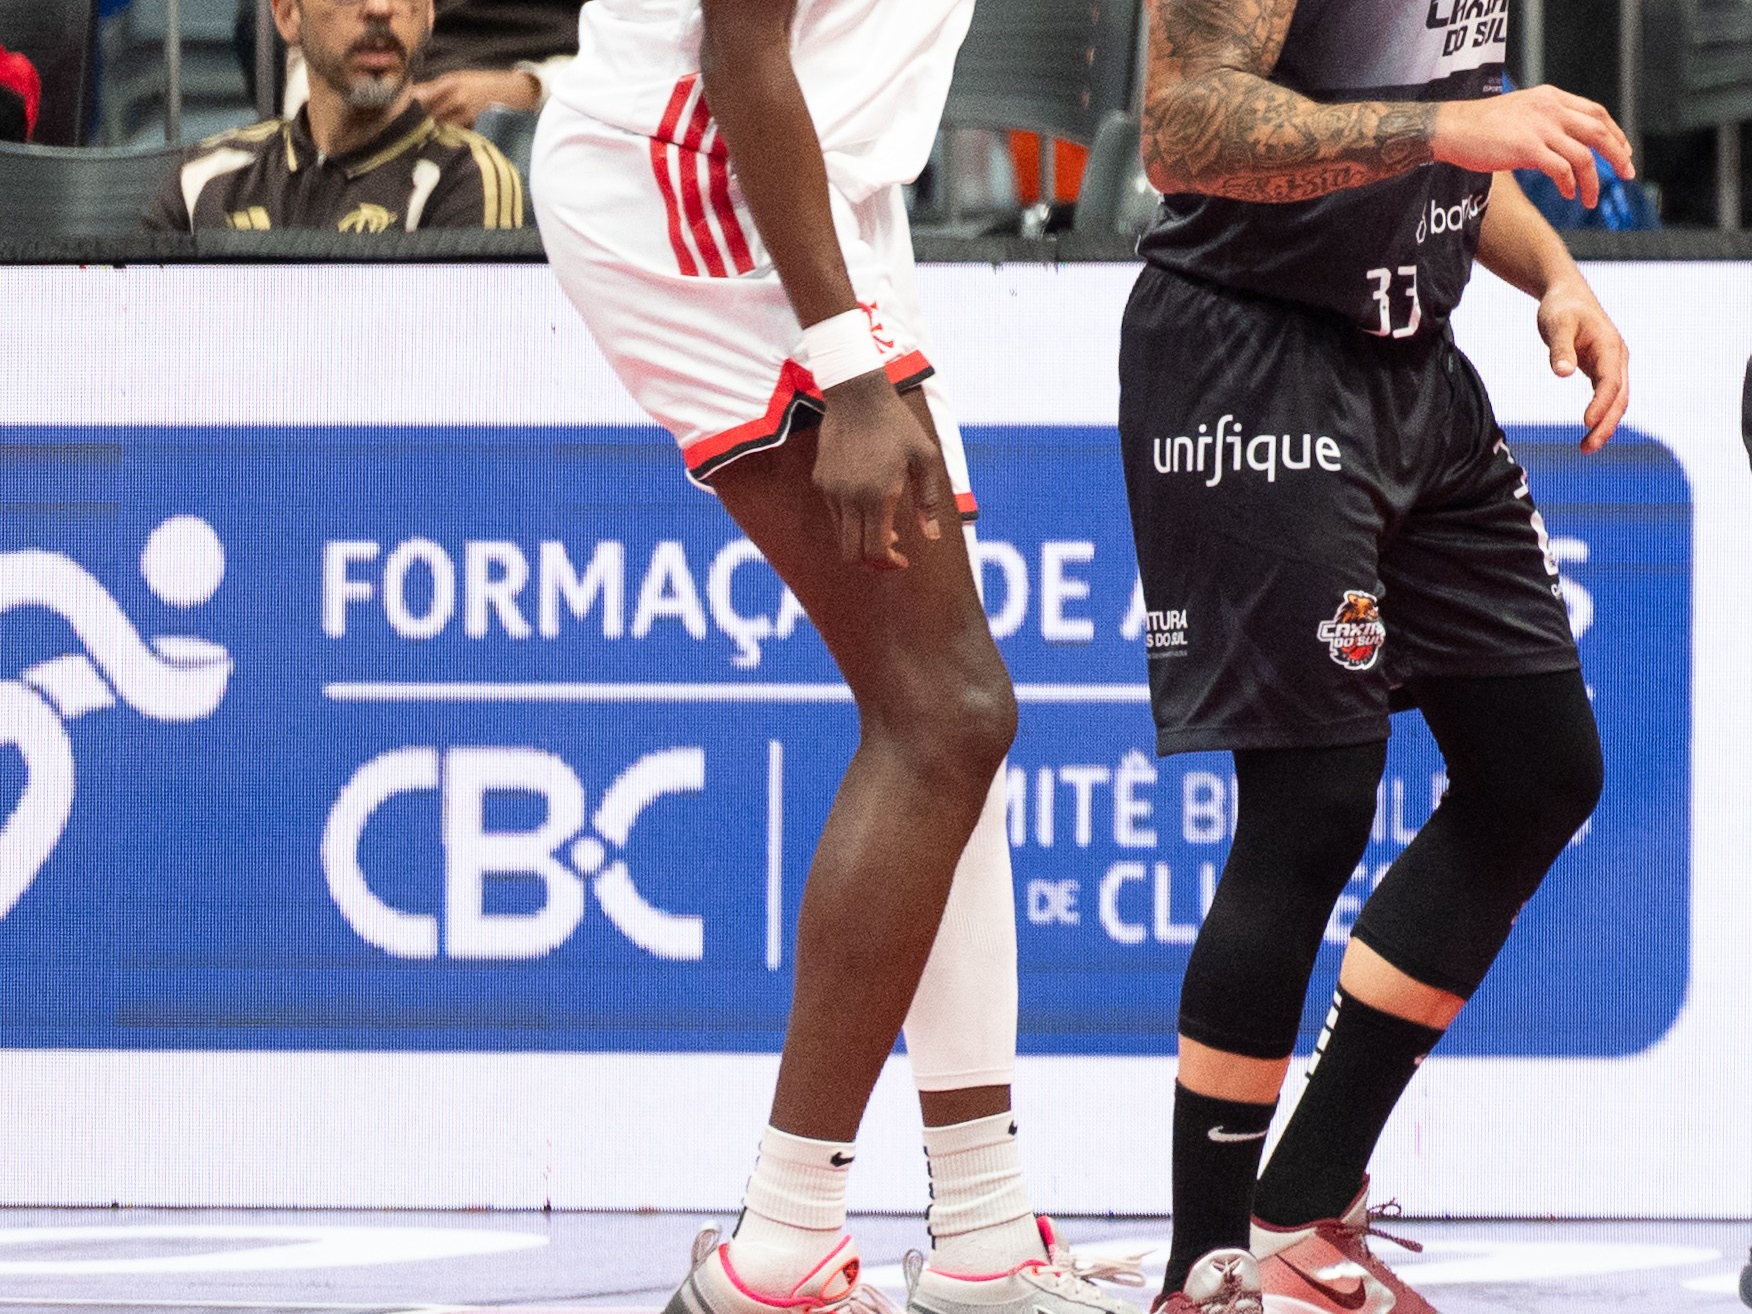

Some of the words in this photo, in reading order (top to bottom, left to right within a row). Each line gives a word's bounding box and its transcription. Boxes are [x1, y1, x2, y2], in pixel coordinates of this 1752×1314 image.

[1442, 24, 1469, 57] DO
[1153, 415, 1342, 487] unifique
[321, 536, 814, 669] FORMAÇ
[1321, 621, 1384, 638] CAXIA
[320, 746, 706, 962] CBC
[1026, 878, 1082, 926] DE
